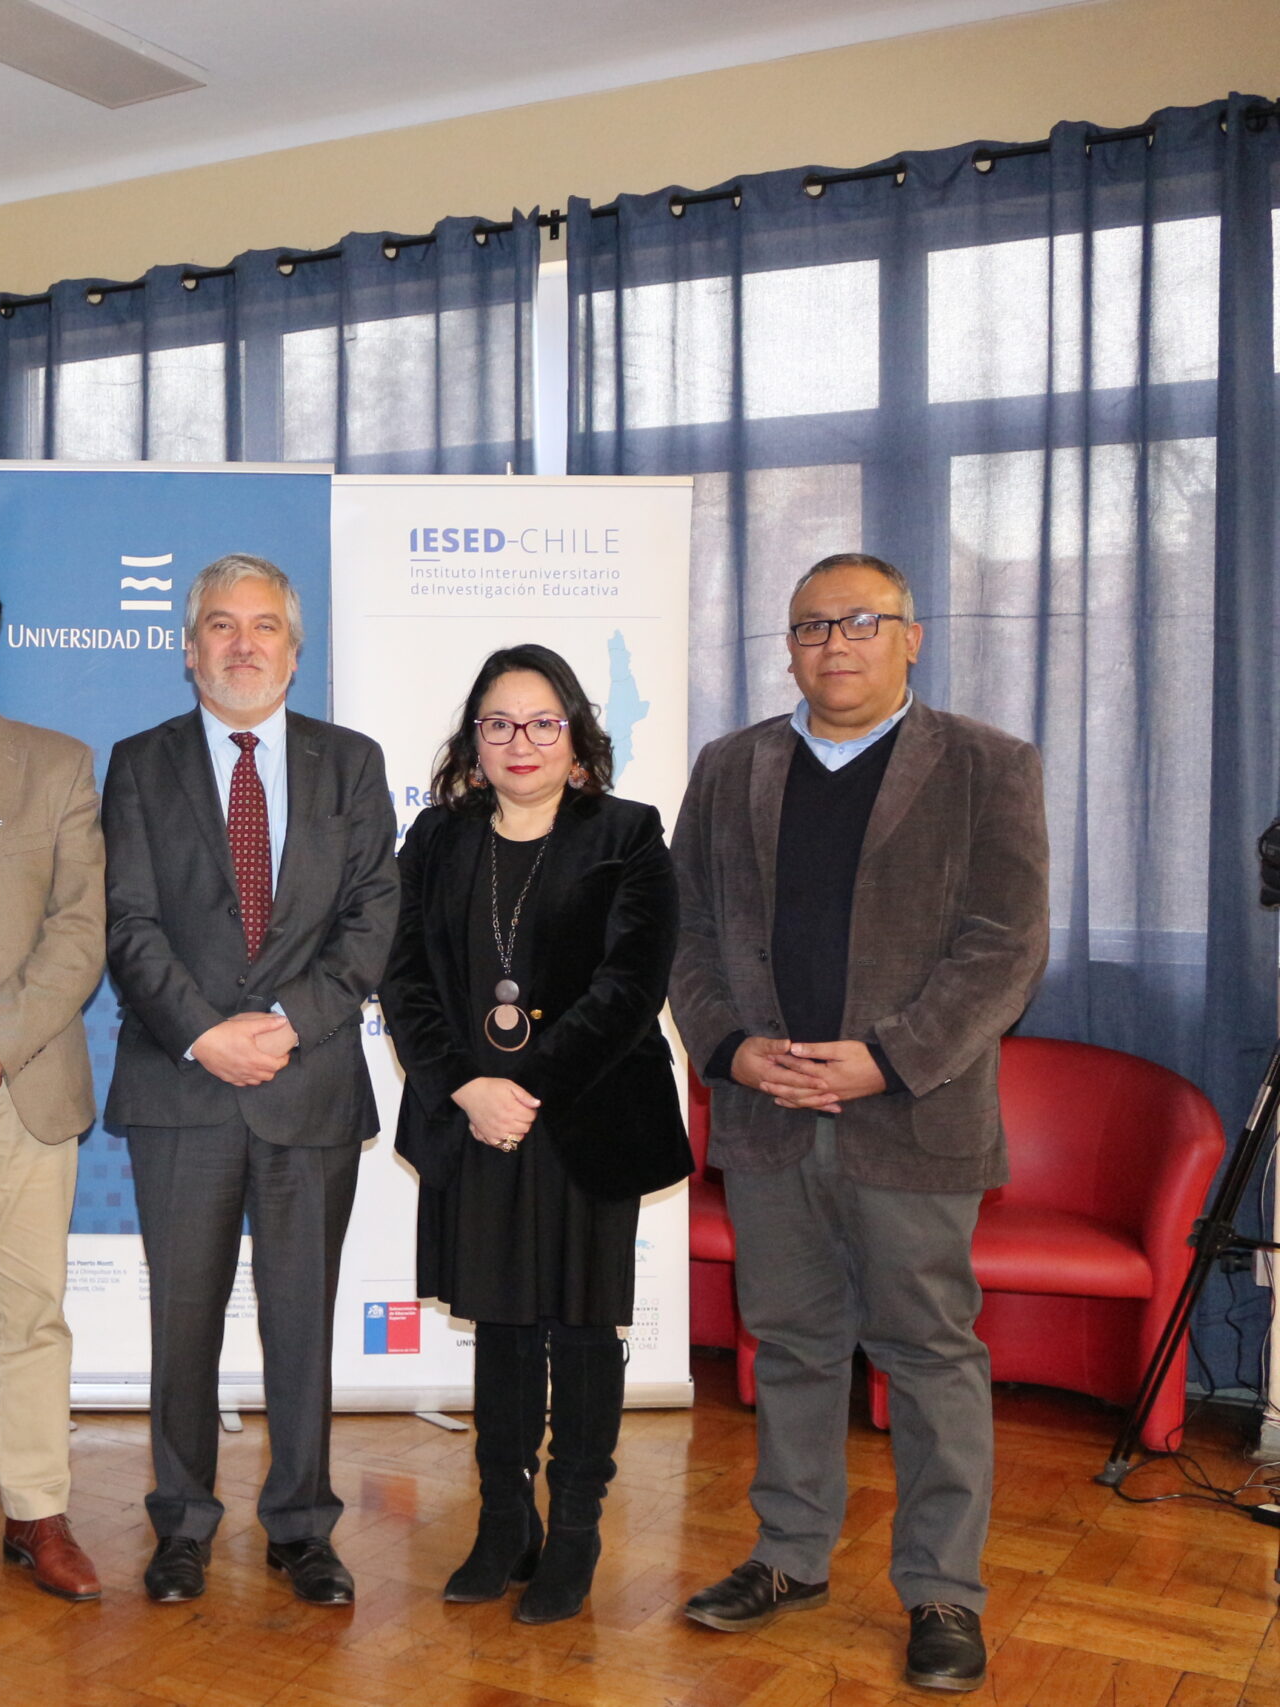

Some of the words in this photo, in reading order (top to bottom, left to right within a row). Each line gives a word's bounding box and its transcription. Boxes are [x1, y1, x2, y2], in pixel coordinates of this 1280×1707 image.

[410, 528, 619, 553] IESED-CHILE
[410, 566, 476, 578] Instituto
[480, 568, 620, 580] Interuniversitario
[411, 582, 429, 595] de
[433, 583, 536, 599] Investigación
[543, 584, 618, 596] Educativa
[8, 624, 140, 649] UNIVERSIDAD
[147, 626, 175, 650] DE
